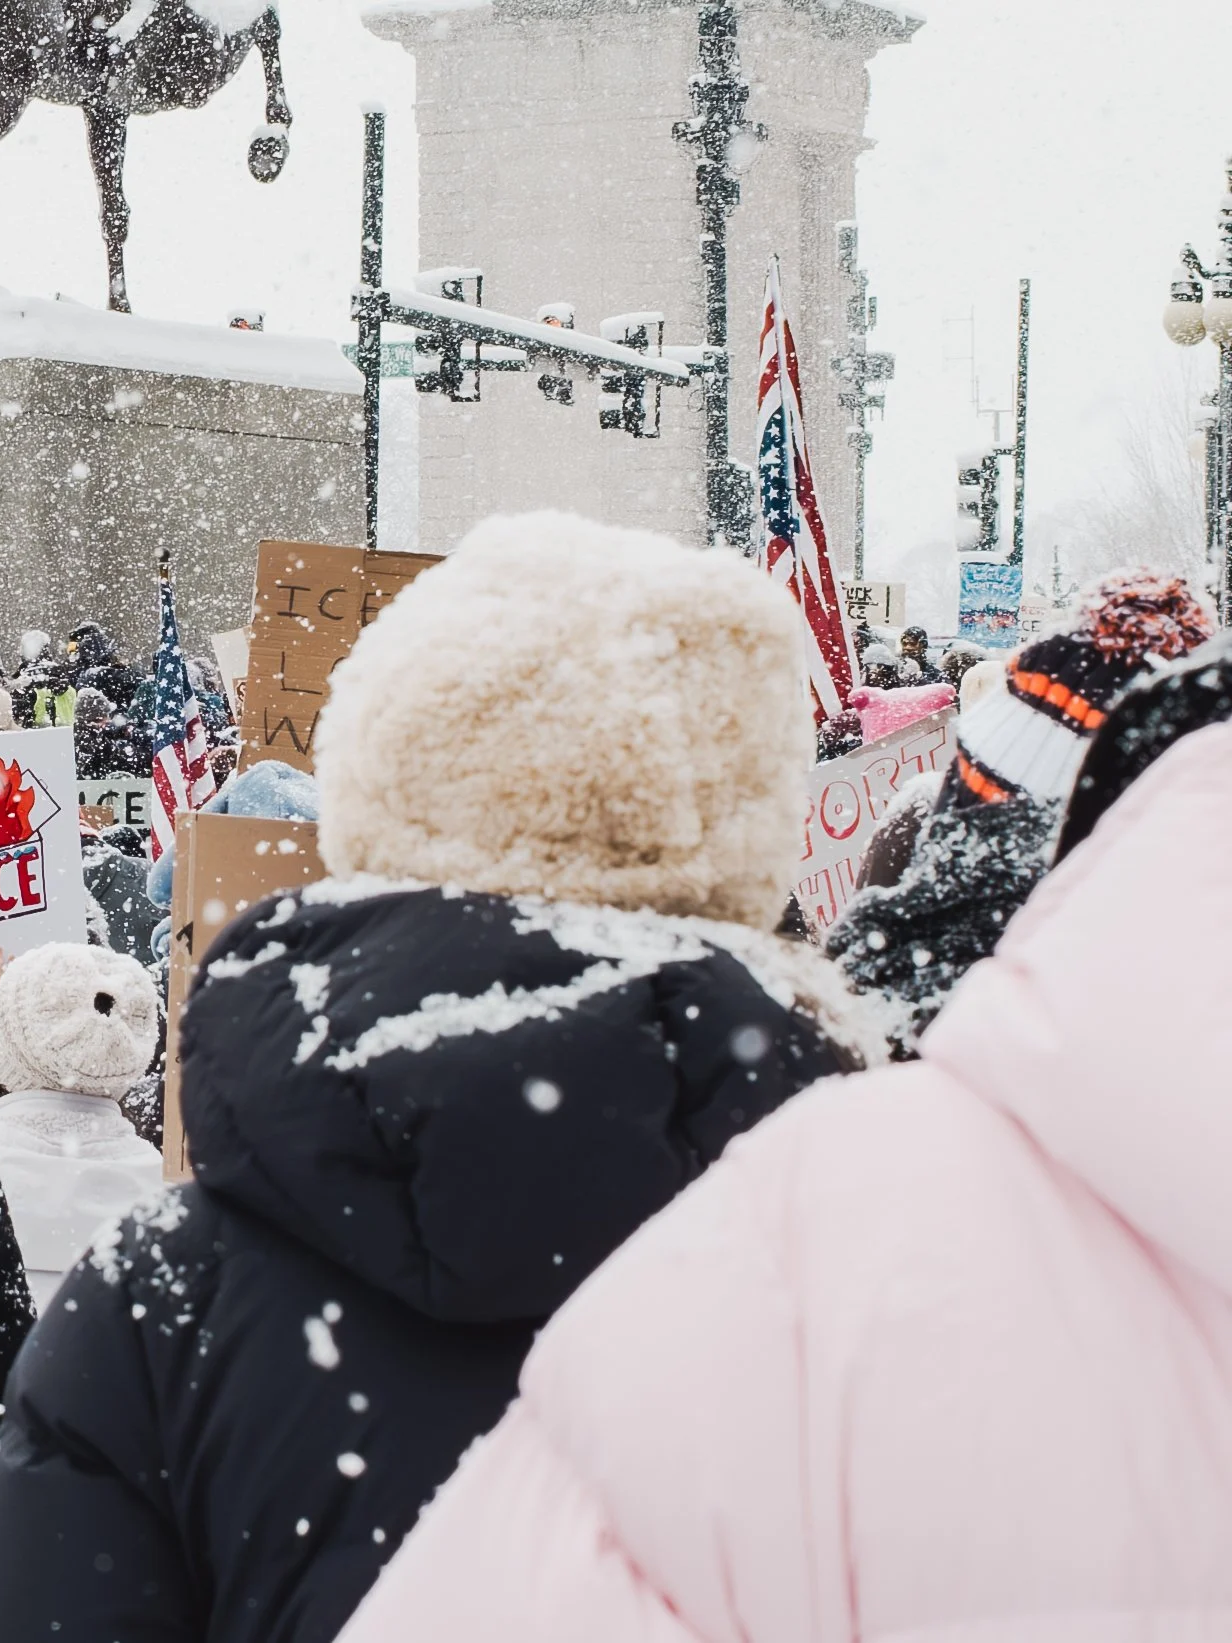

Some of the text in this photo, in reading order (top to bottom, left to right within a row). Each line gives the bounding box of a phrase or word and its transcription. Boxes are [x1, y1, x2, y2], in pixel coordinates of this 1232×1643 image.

[840, 581, 873, 602] UCK
[276, 585, 393, 628] ICE
[847, 604, 867, 619] CE
[1021, 620, 1041, 632] CE
[800, 726, 946, 862] ORT
